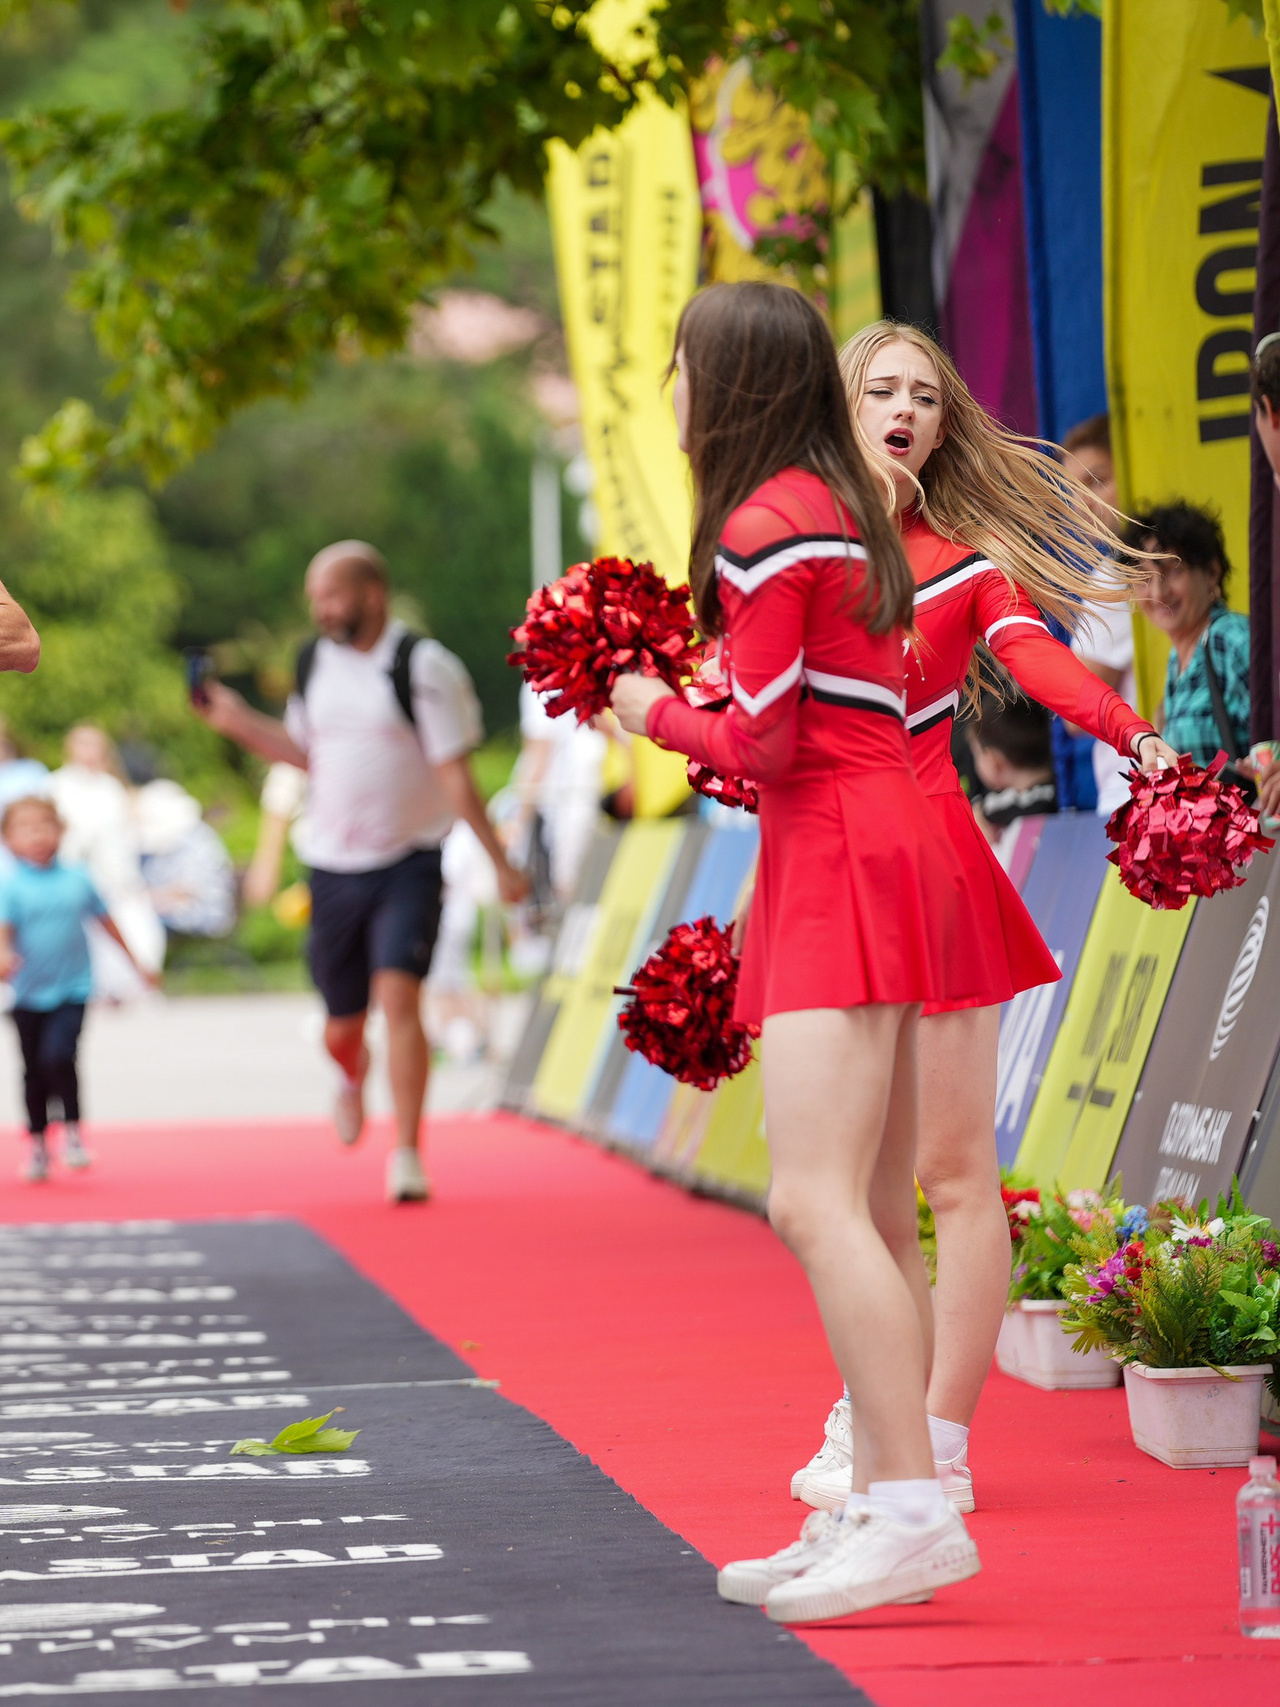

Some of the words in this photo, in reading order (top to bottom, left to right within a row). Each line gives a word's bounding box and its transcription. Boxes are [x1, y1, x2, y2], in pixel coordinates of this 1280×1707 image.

[23, 1457, 372, 1482] STAR
[46, 1543, 444, 1575] STAR
[70, 1650, 530, 1688] STAR
